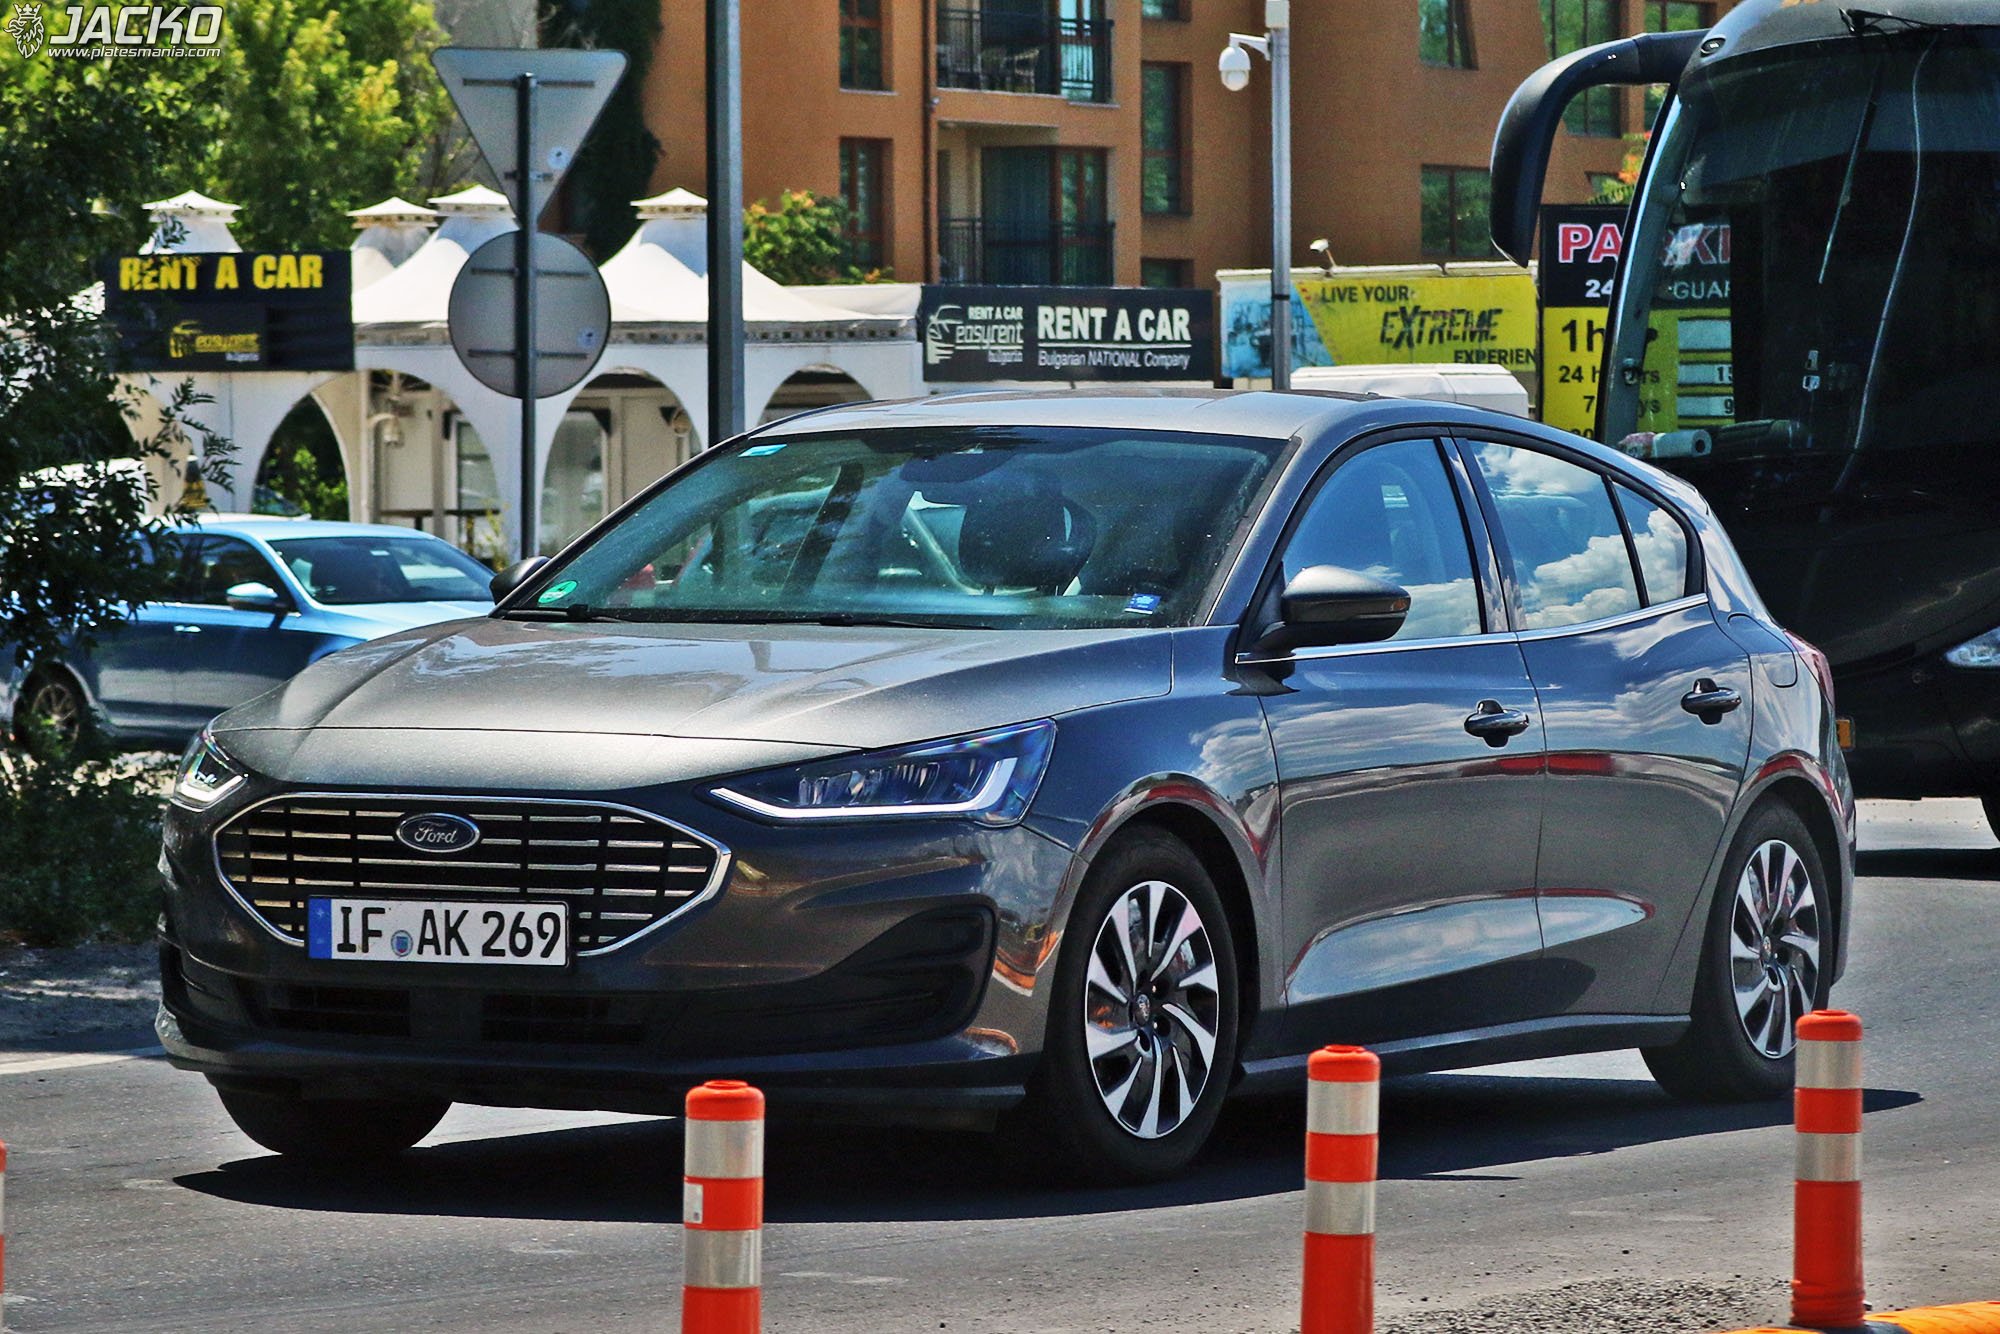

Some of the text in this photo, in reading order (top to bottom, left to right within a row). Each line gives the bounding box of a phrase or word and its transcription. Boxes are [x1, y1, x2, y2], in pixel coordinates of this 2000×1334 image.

[119, 254, 323, 290] RENT A CAR
[1321, 285, 1409, 303] LIVE YOUR
[968, 306, 1023, 320] RENT A CAR
[1038, 306, 1192, 342] RENT A CAR
[1380, 305, 1503, 350] EXTREME
[1038, 350, 1190, 370] Bulgarian NATIONAL Company
[1559, 366, 1583, 383] 24
[1584, 395, 1596, 413] 7
[414, 821, 457, 844] Ford
[337, 906, 561, 958] IF AK 269
